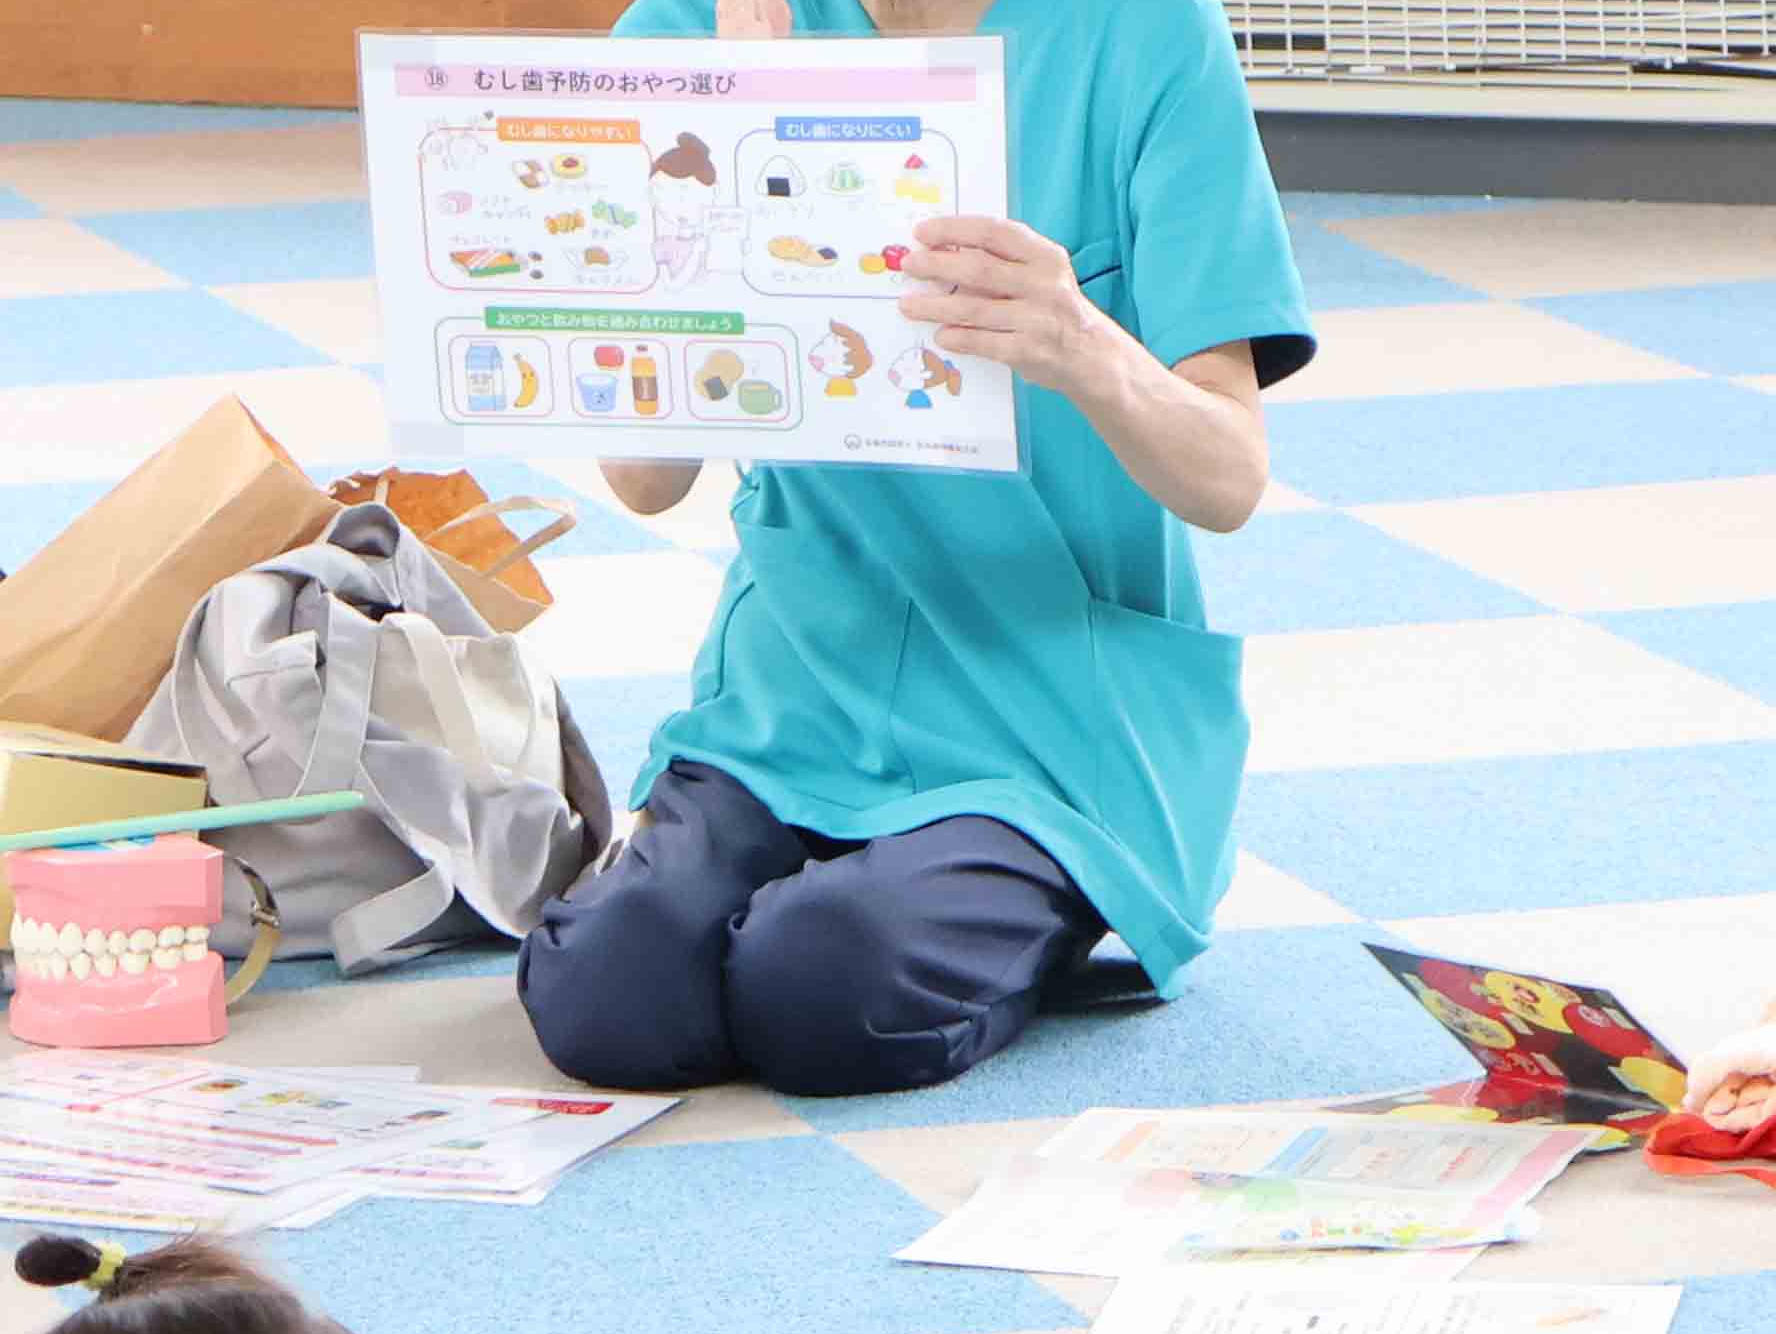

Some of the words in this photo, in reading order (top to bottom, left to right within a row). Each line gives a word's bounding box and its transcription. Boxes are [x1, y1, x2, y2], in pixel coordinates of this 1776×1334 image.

[474, 69, 737, 95] むし歯予防のおやつ選び
[785, 122, 912, 139] むし歯になりにくい
